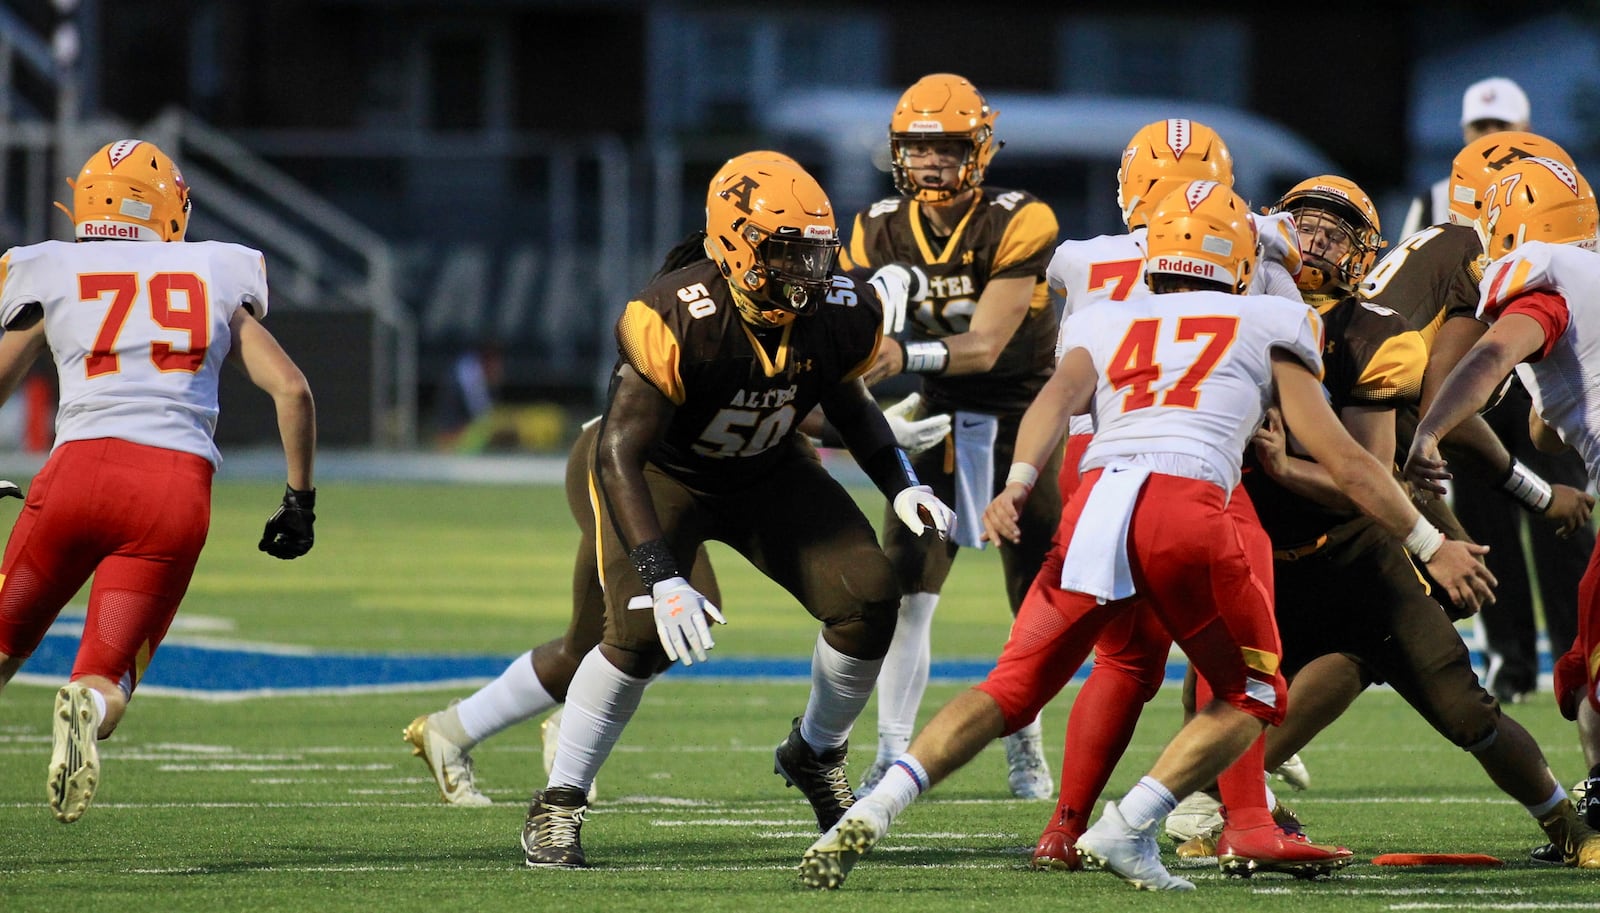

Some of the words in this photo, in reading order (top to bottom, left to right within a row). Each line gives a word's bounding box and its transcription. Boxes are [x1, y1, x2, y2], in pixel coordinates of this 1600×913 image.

[720, 175, 760, 215] A
[84, 223, 139, 239] Riddell
[928, 275, 974, 298] TER
[1087, 256, 1145, 302] 7
[1158, 258, 1215, 278] Riddell
[676, 276, 717, 320] 50
[77, 271, 211, 380] 79
[1105, 314, 1241, 414] 47
[729, 384, 798, 409] ALTER
[690, 403, 797, 459] 50
